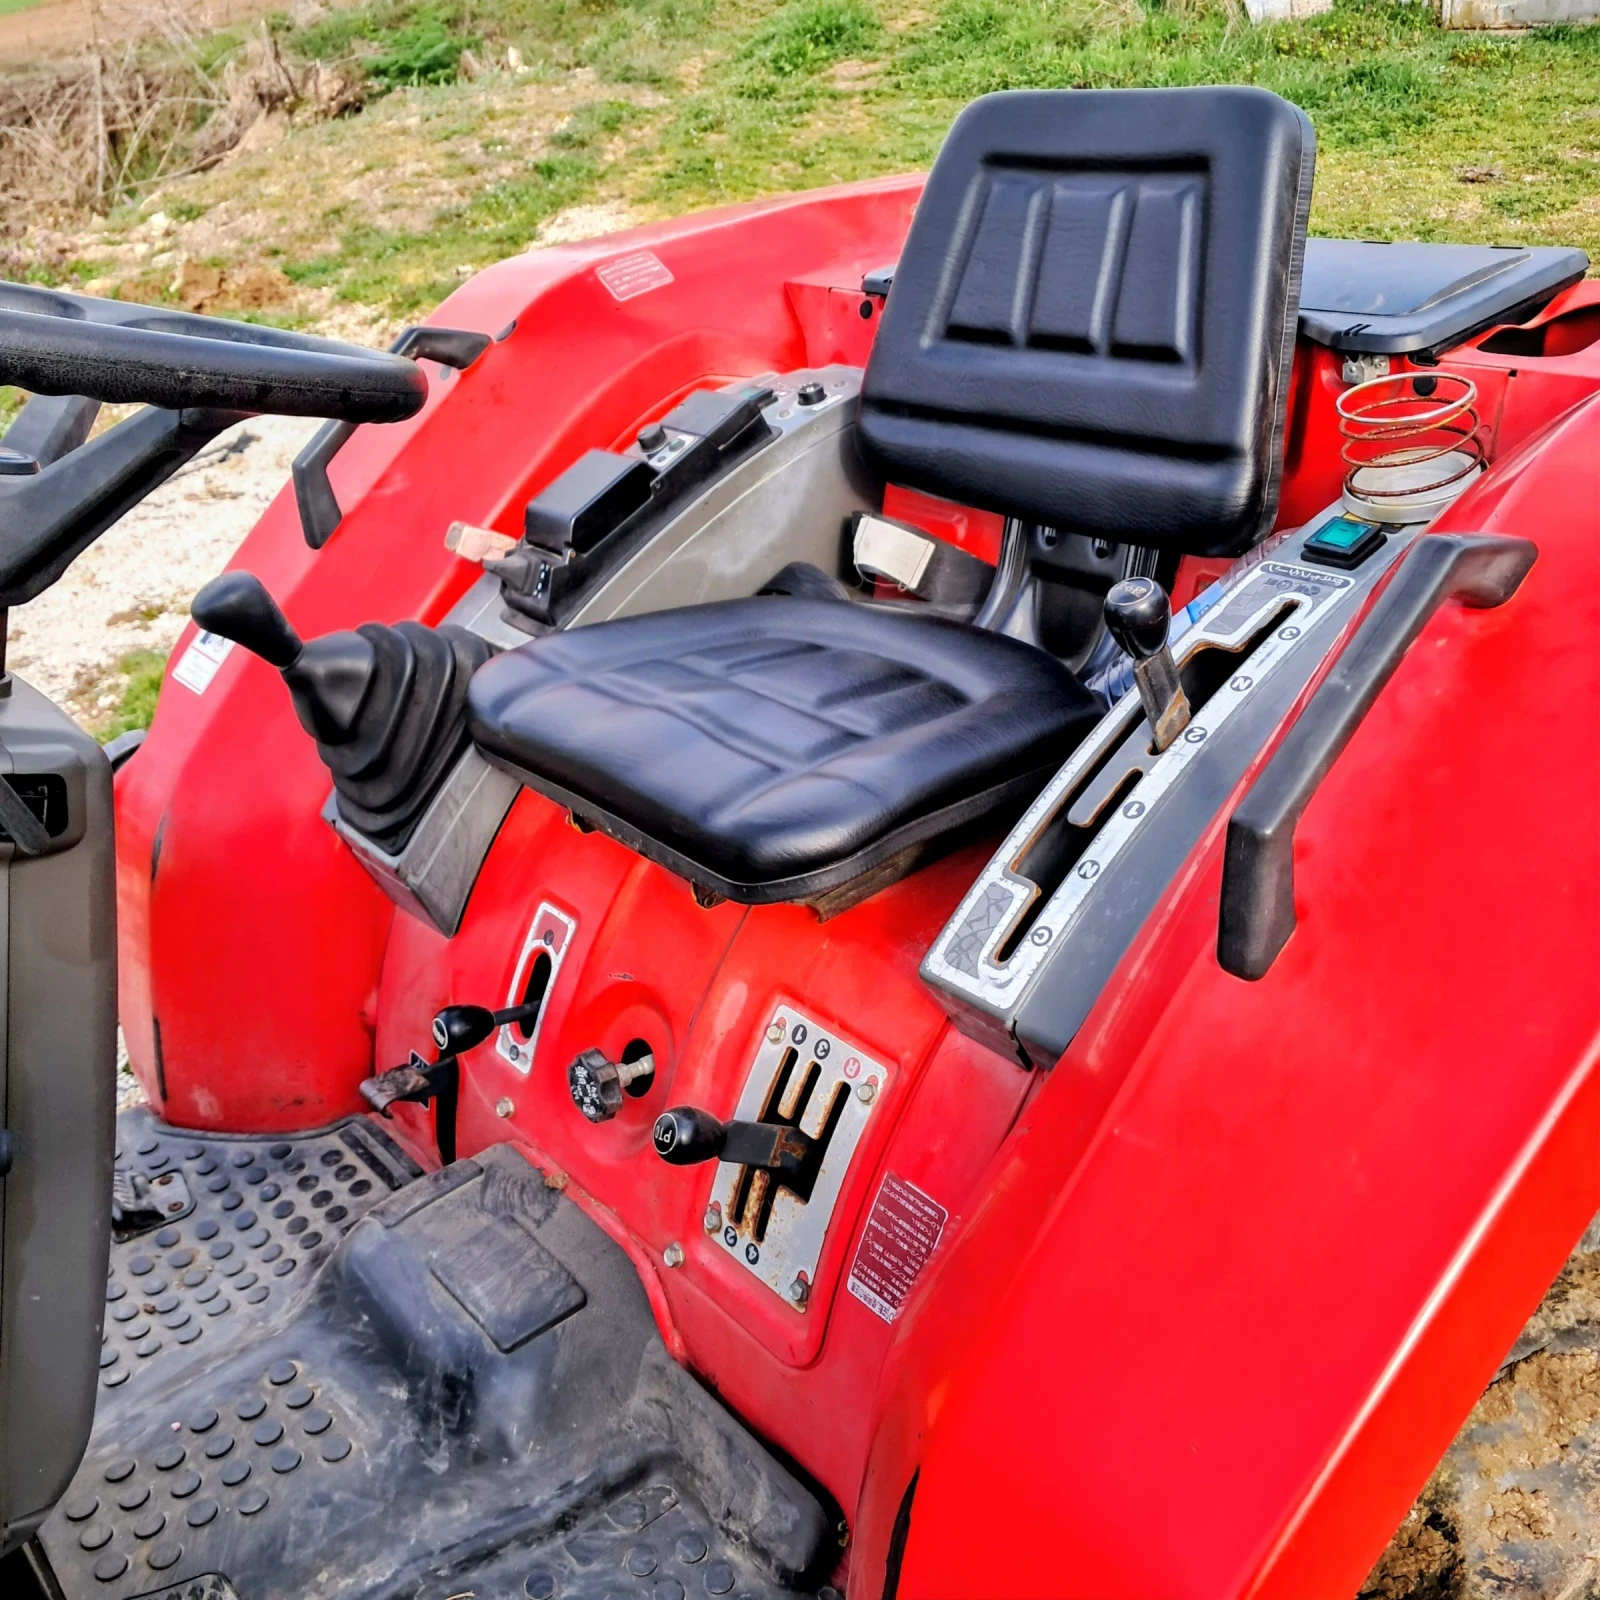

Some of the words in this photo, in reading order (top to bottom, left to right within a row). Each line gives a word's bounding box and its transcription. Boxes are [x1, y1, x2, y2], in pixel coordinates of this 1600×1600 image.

[1281, 627, 1298, 639] 3
[1231, 676, 1252, 691] N
[1187, 727, 1206, 742] 2
[1126, 803, 1140, 817] 1
[1079, 861, 1099, 878] N
[795, 1026, 804, 1041] 1
[816, 1040, 828, 1057] 3
[845, 1058, 859, 1077] R
[654, 1125, 673, 1144] PTO
[726, 1227, 736, 1244] 2
[748, 1245, 757, 1260] 4
